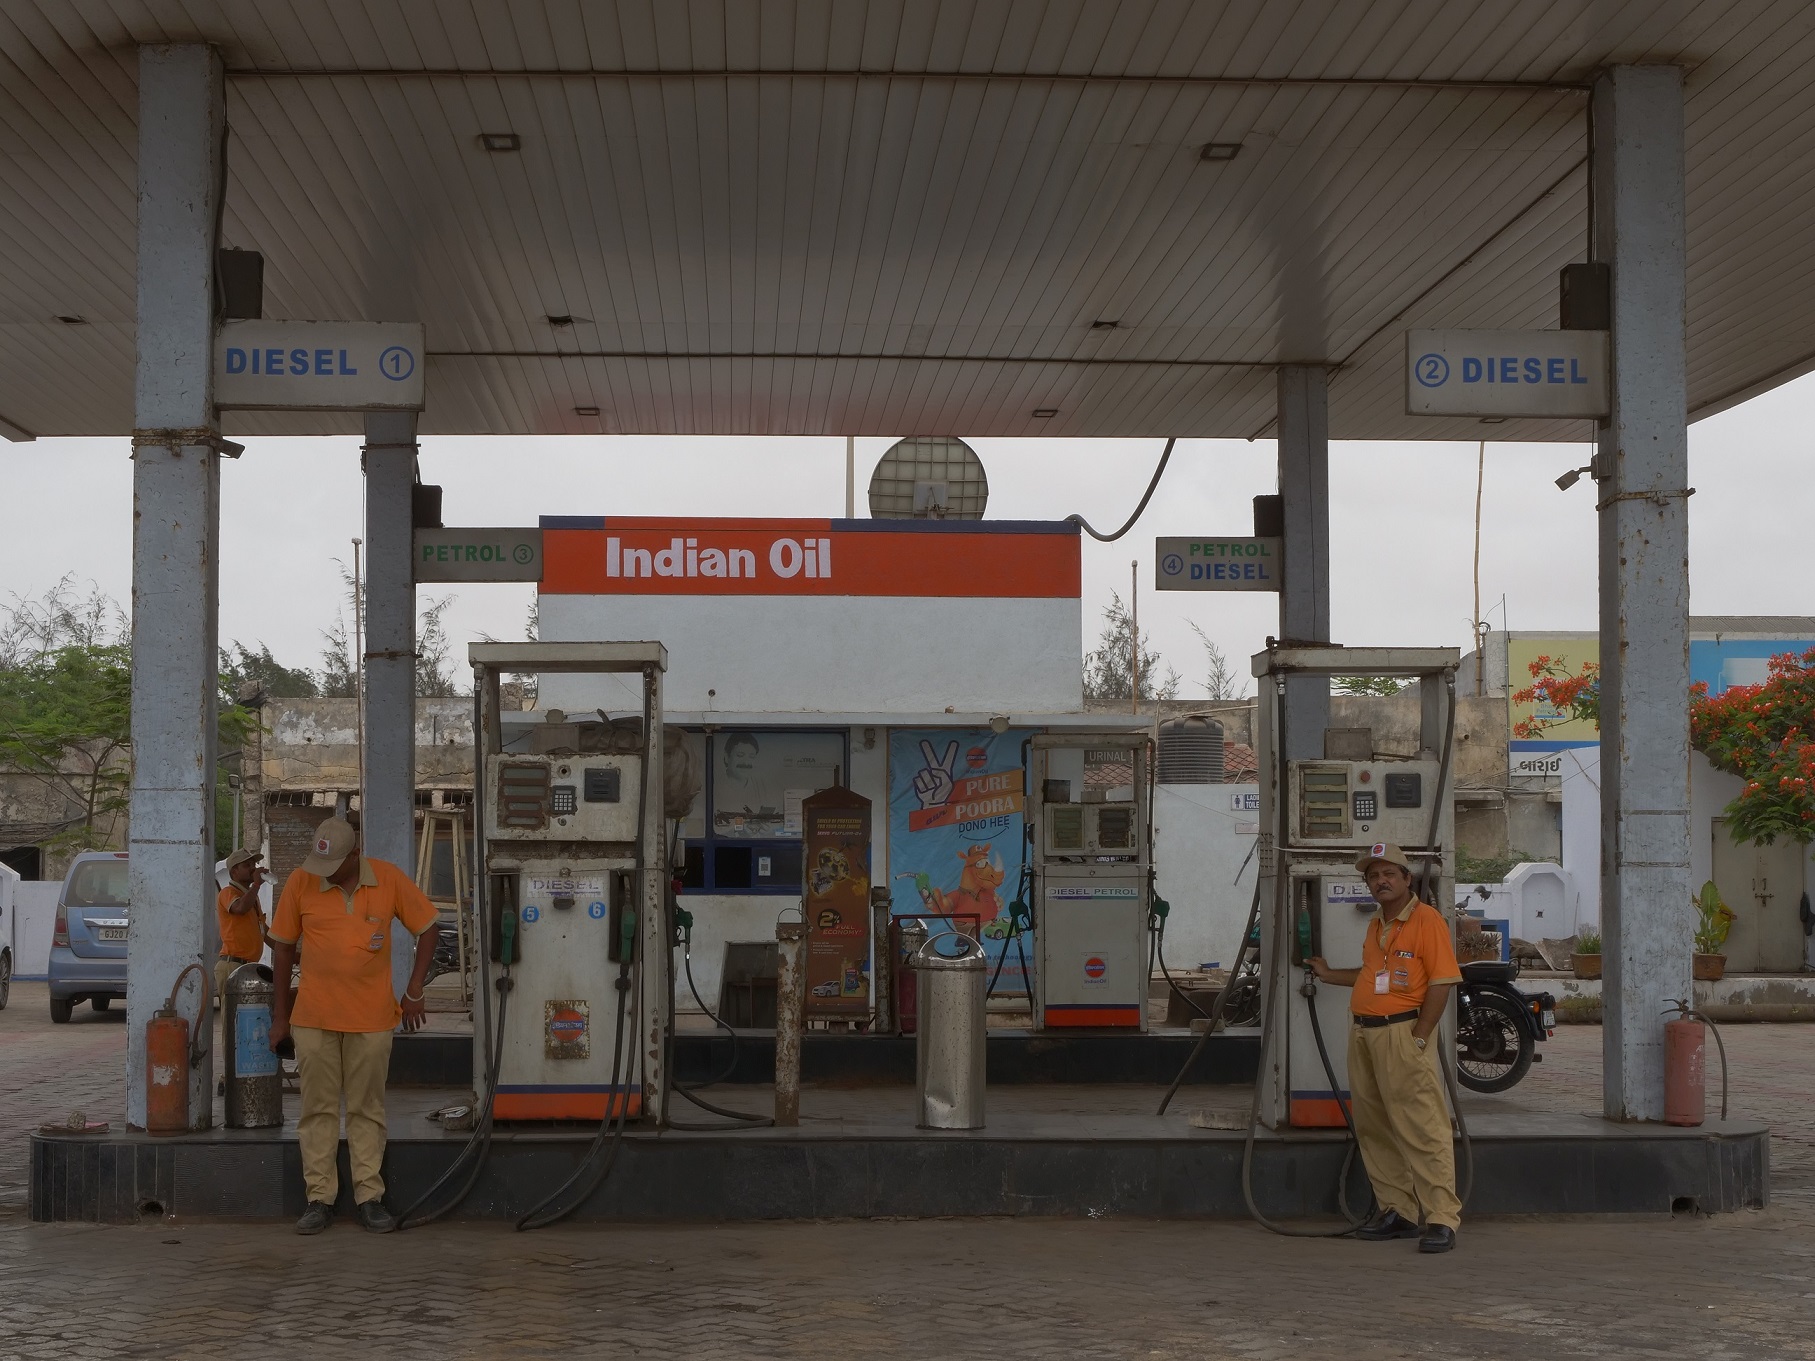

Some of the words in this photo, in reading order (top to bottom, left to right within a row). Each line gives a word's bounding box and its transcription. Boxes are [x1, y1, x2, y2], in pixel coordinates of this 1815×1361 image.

[226, 348, 357, 375] DIESEL
[1463, 358, 1588, 384] DIESEL
[422, 545, 507, 561] PETROL
[606, 537, 756, 578] Indian
[769, 537, 832, 578] Oil
[1189, 544, 1271, 556] PETROL
[1190, 563, 1270, 580] DIESEL
[1089, 751, 1127, 761] URINAL
[966, 774, 1012, 796] PURE
[955, 795, 1015, 820] POORA
[958, 819, 987, 833] DONO
[989, 815, 1010, 828] HEE
[533, 880, 599, 890] DIESEL
[526, 907, 535, 921] 5
[592, 903, 602, 917] 6
[104, 930, 124, 939] GJ20
